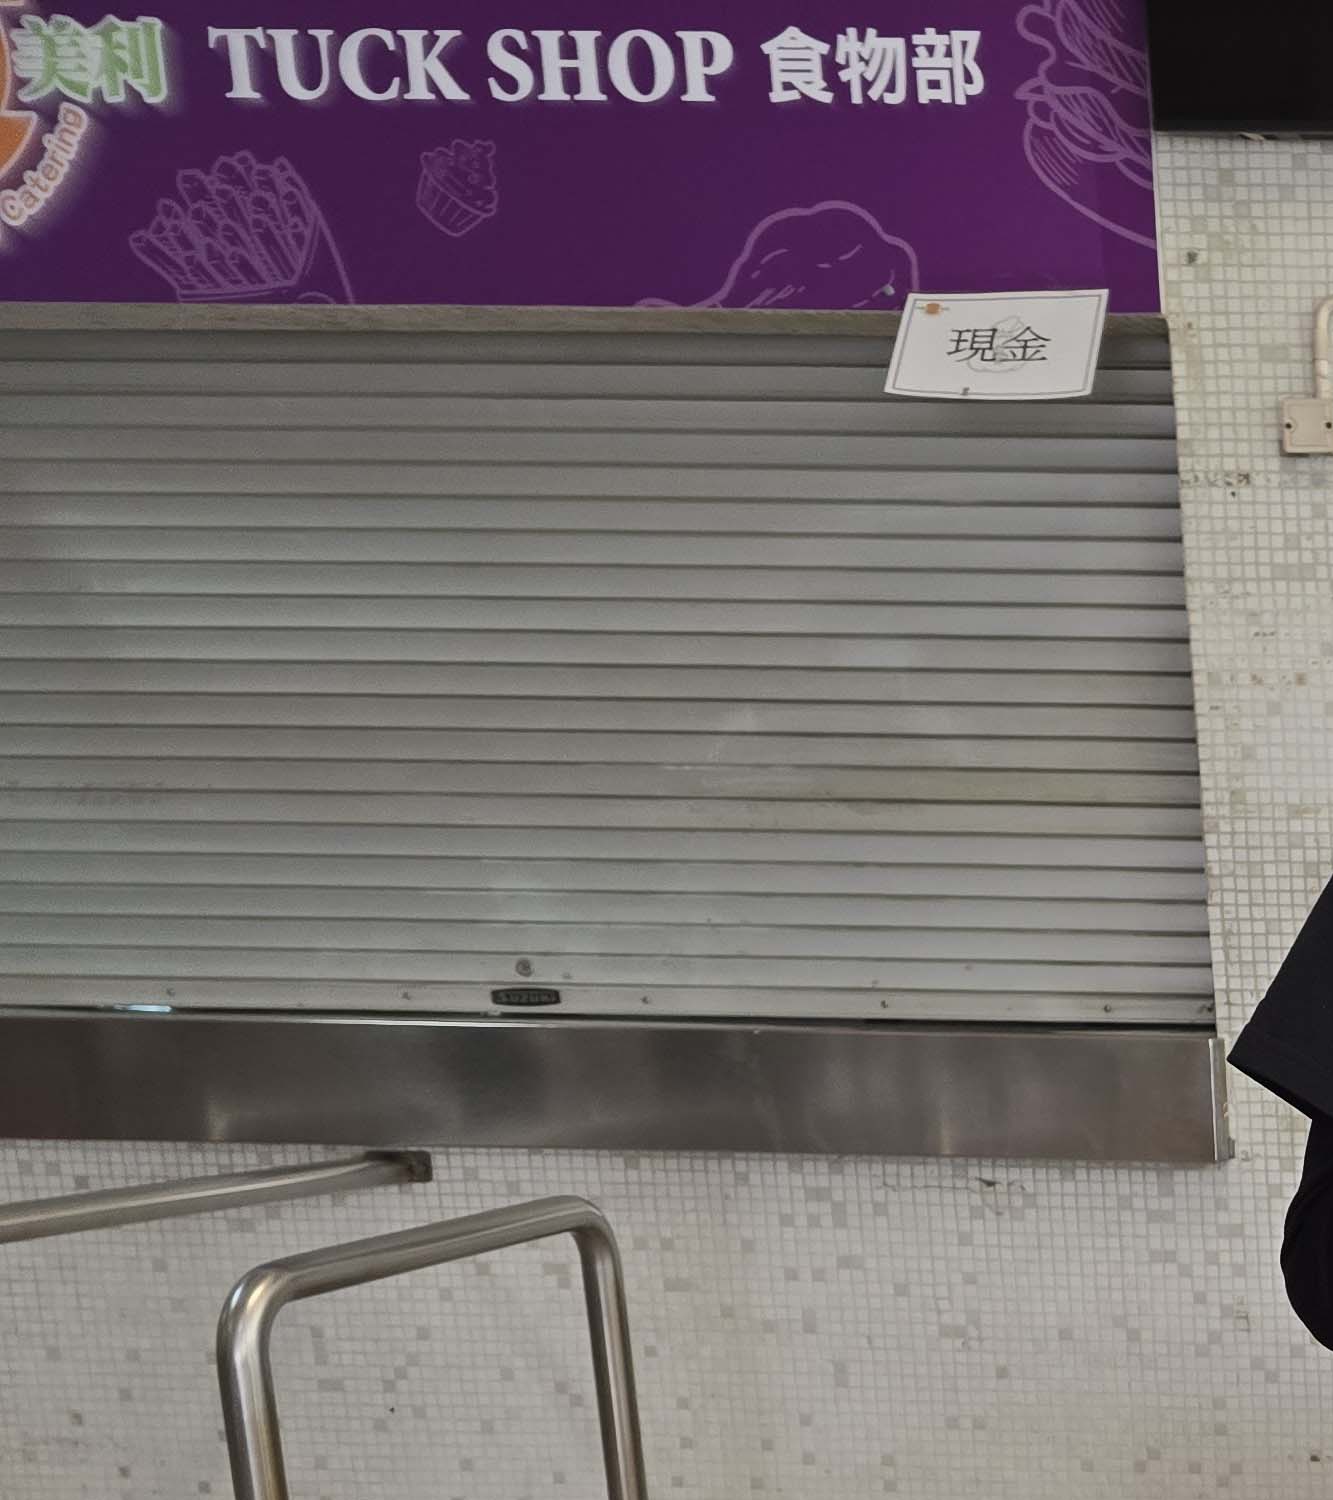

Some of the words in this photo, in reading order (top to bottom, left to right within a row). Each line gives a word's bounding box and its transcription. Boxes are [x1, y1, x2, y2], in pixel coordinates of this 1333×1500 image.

[11, 15, 166, 102] 美利
[208, 27, 471, 101] TUCK
[487, 28, 733, 102] SHOP
[761, 26, 985, 105] 食物部
[1, 102, 87, 226] Catering
[947, 325, 1051, 364] 現金
